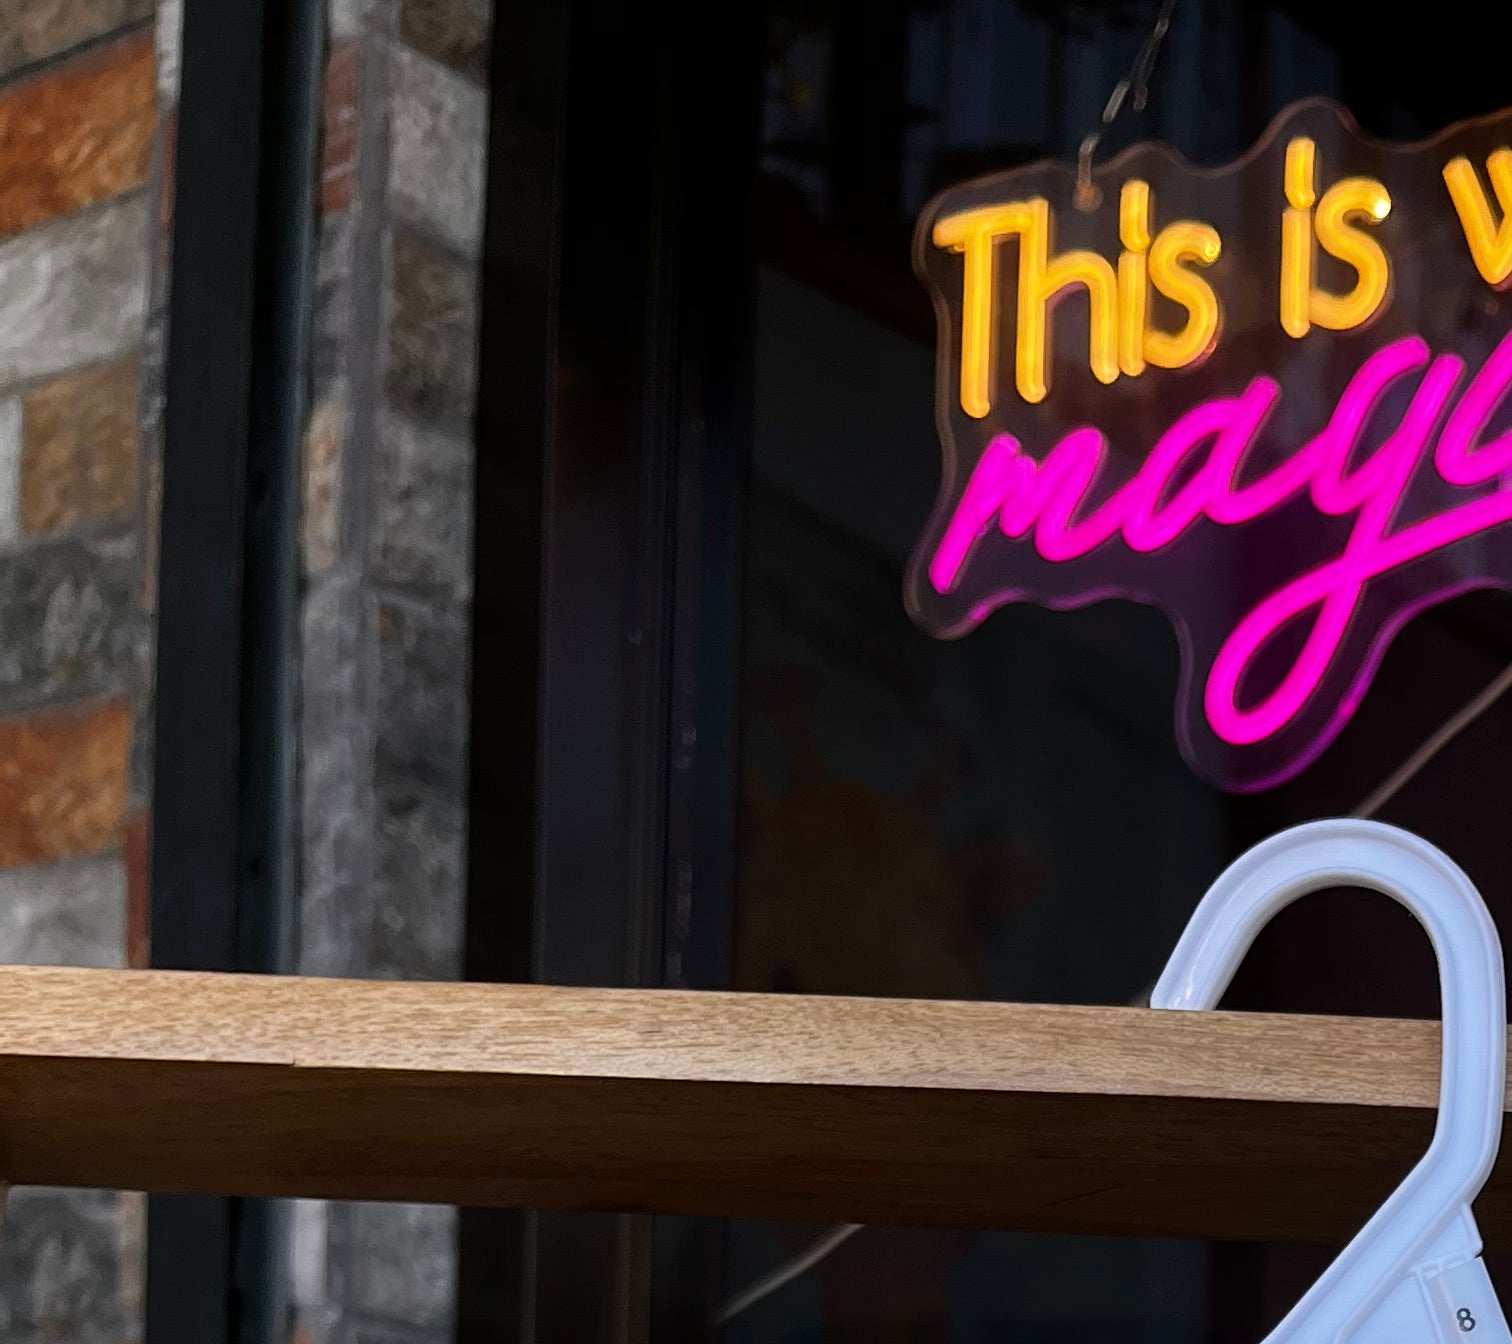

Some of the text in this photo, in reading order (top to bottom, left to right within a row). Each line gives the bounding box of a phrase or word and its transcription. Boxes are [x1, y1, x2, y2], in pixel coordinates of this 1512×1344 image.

[932, 178, 1222, 419] This
[1280, 136, 1393, 339] is
[1456, 1307, 1477, 1332] 8
